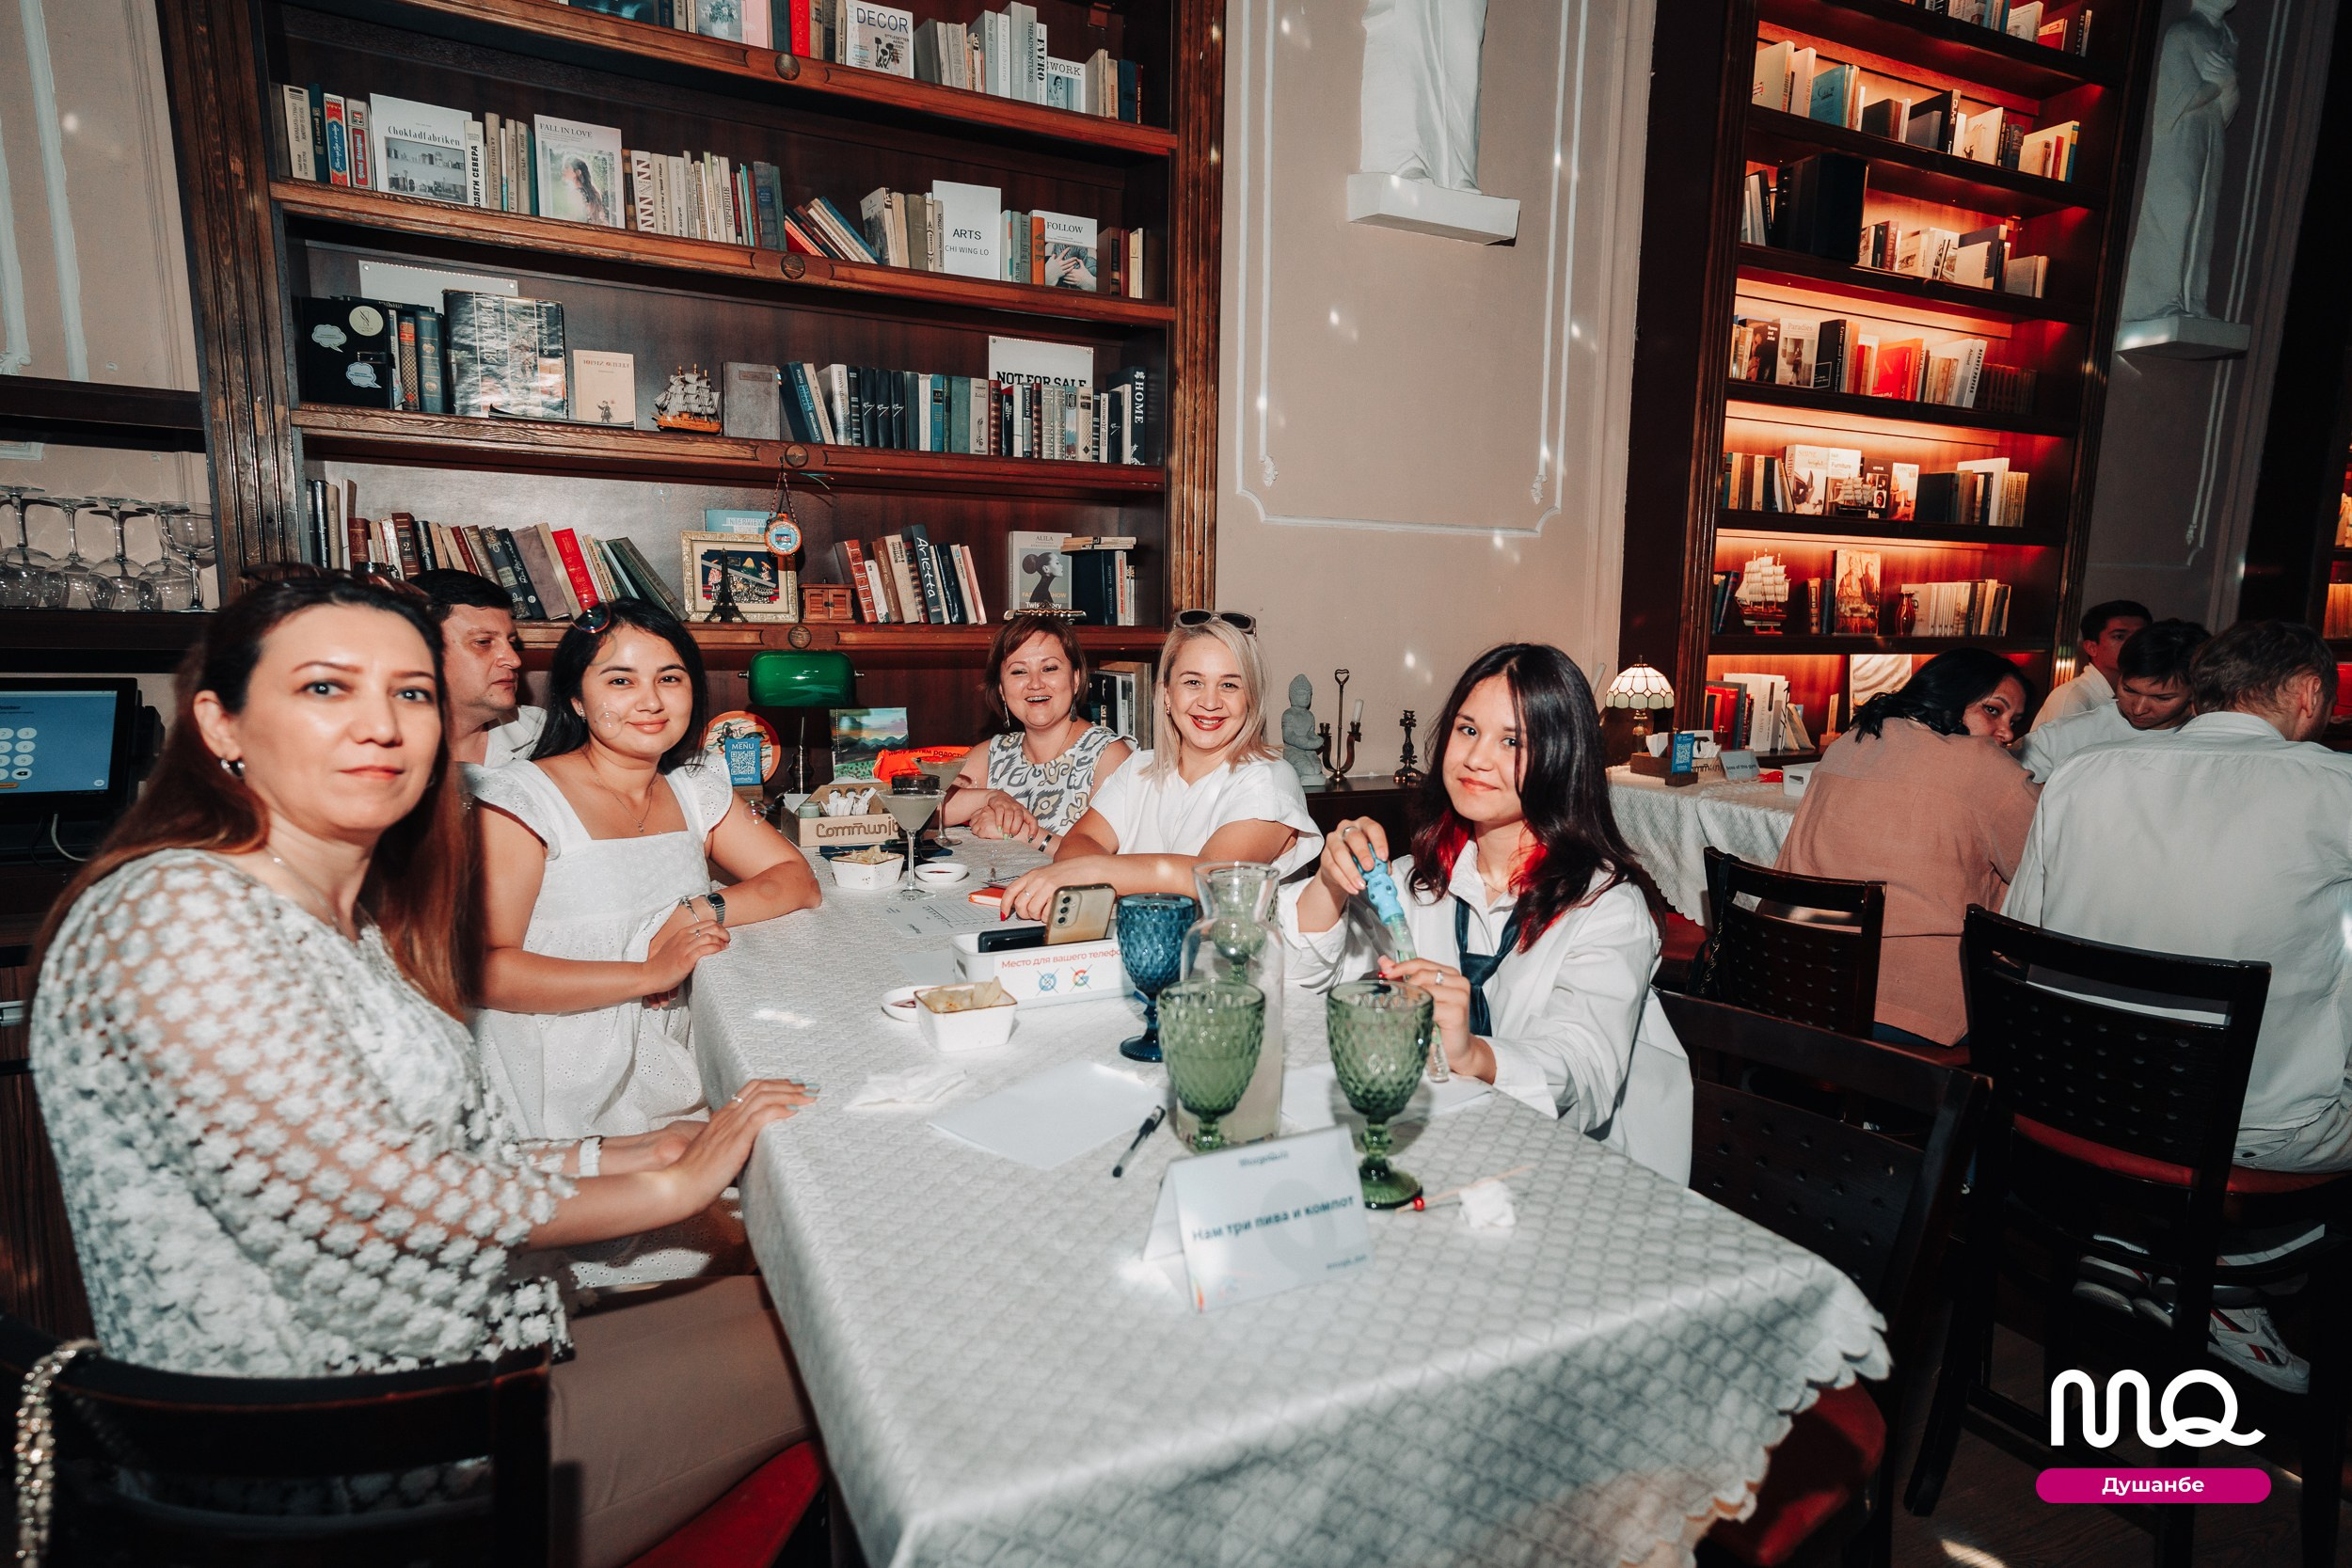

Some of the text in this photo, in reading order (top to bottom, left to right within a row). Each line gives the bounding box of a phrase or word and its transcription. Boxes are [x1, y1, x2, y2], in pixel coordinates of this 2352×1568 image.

[856, 8, 910, 34] DECOR
[388, 125, 461, 147] Chokladfabriken
[539, 122, 593, 138] FALL IN LOVE
[470, 146, 481, 207] ОДЯГИ СЕВЕРА
[723, 185, 733, 229] ЧЕРЧЕНИЕ
[952, 228, 982, 242] ARTS
[1046, 221, 1084, 234] FOLLOW
[945, 245, 990, 257] CHI WING LO
[996, 371, 1087, 388] NOT FOR SALE
[1134, 381, 1144, 424] HOME
[403, 542, 411, 553] 2
[1035, 534, 1054, 543] ALILA
[915, 535, 937, 599] Arletta
[932, 750, 963, 758] радост
[816, 813, 901, 838] Communit
[1001, 947, 1121, 969] Место для вашего телефо
[1192, 1196, 1355, 1242] Нам три пива и компот
